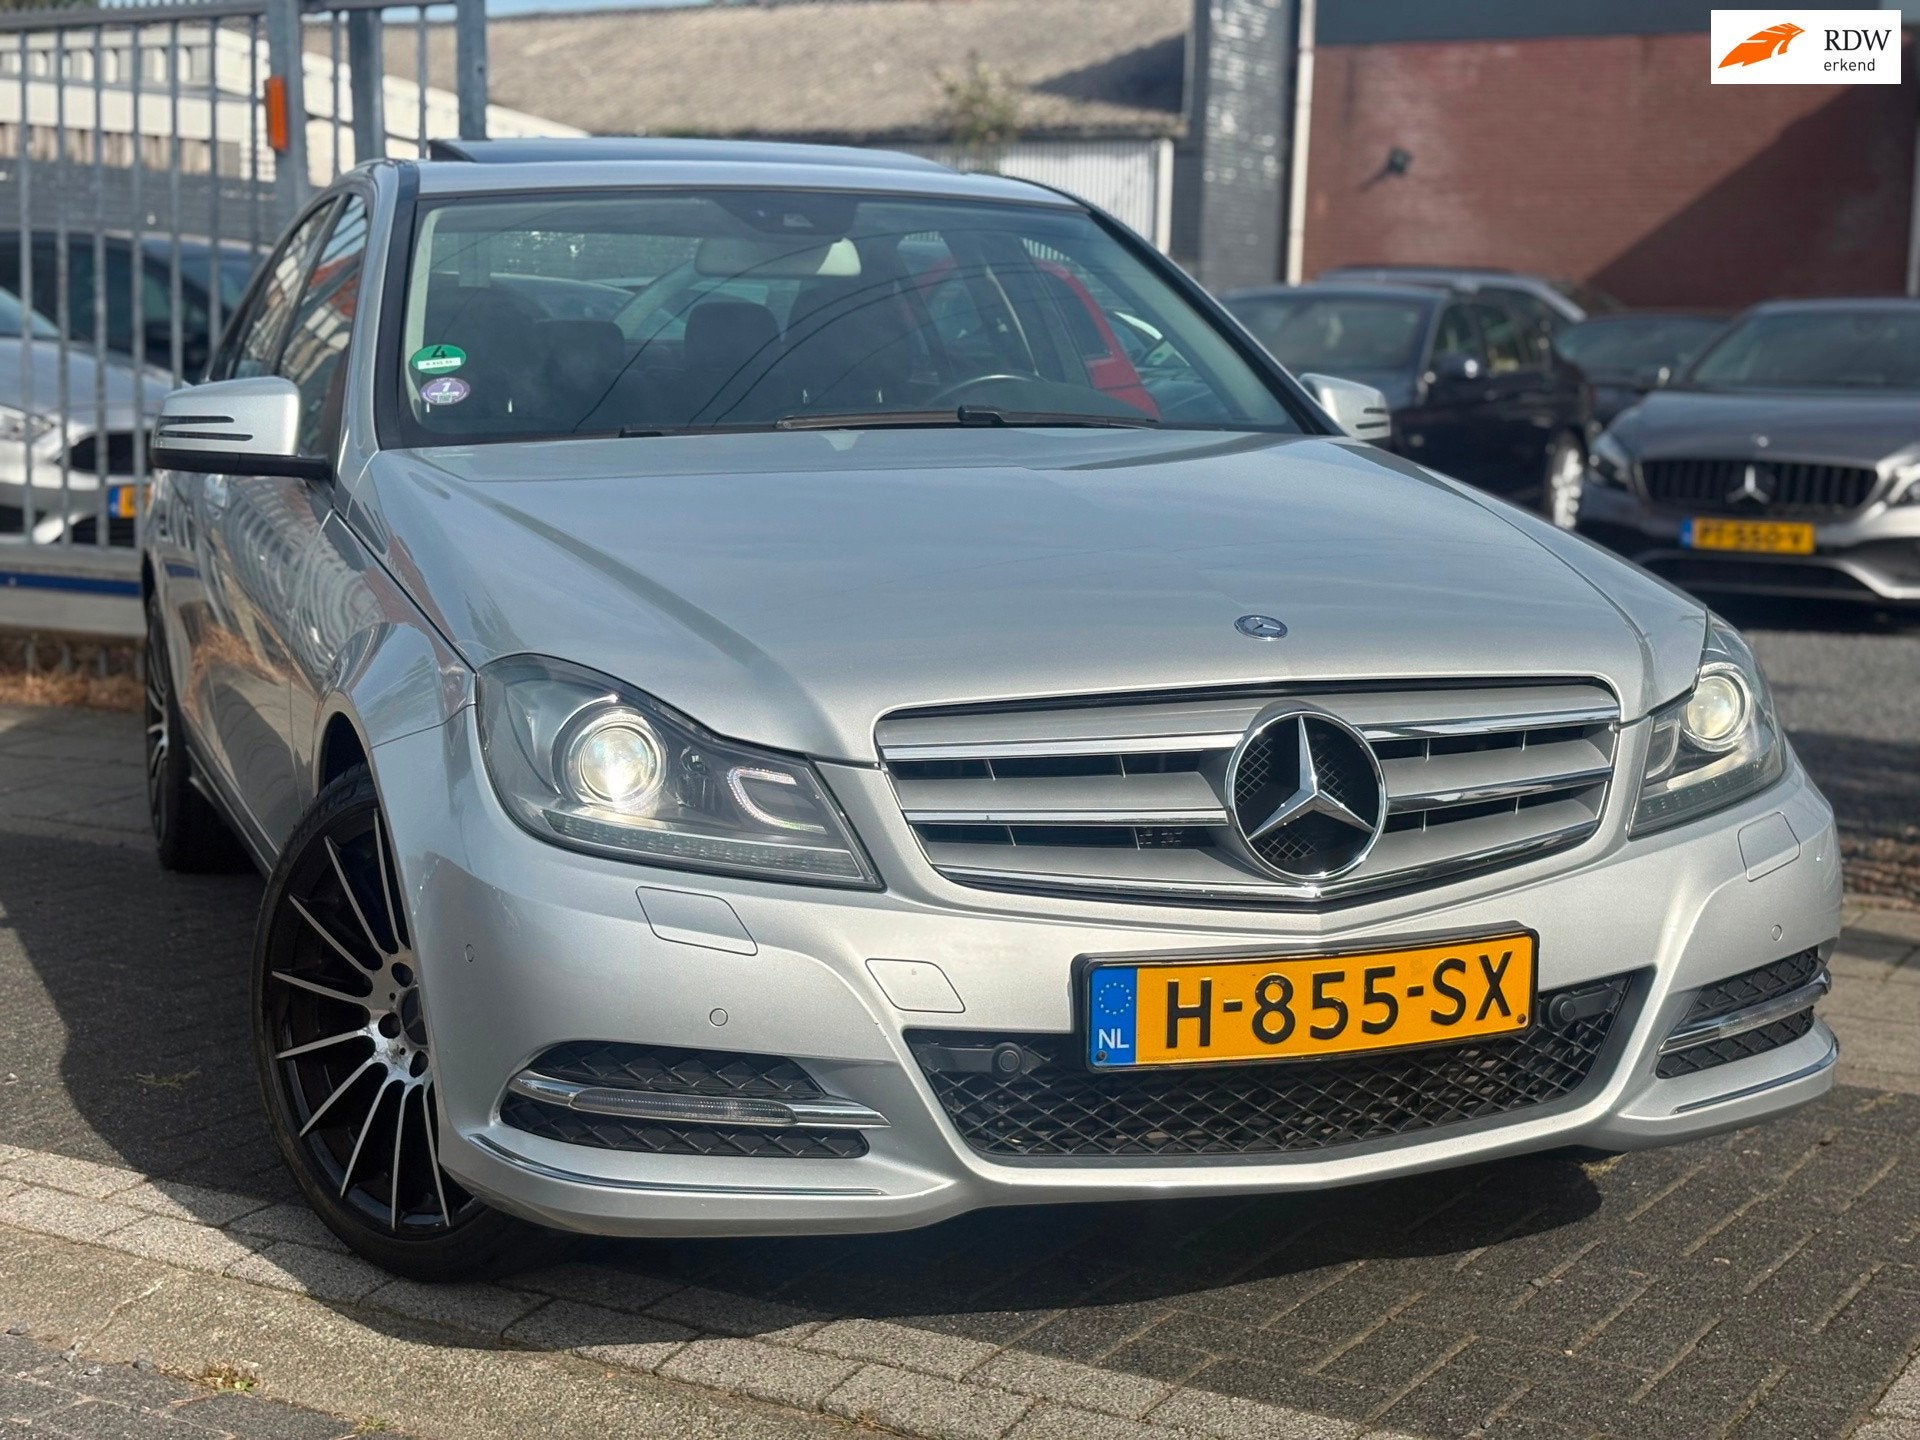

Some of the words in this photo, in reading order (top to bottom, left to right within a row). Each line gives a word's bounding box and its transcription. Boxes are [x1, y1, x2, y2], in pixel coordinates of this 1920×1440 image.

[431, 345, 447, 358] 4
[1166, 951, 1514, 1049] H-855-SX
[1098, 1028, 1130, 1050] NL
